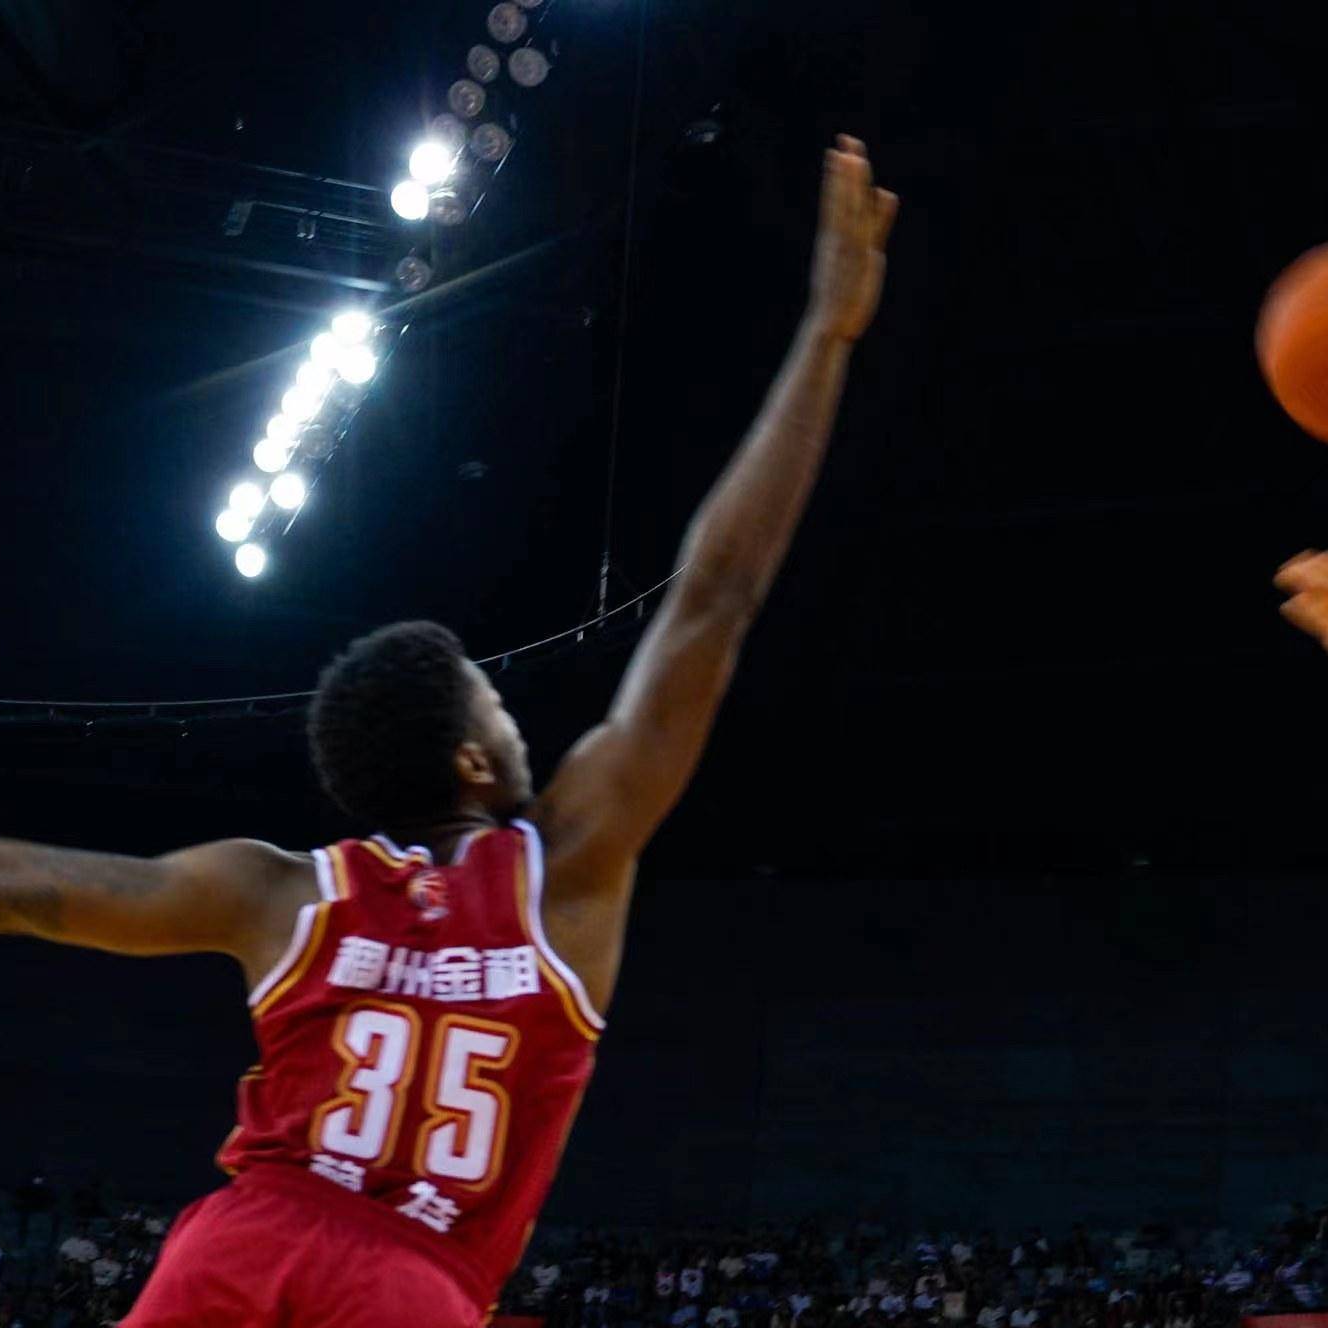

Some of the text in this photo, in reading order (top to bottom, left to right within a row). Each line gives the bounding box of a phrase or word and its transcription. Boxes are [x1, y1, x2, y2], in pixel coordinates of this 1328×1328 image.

[327, 935, 542, 1002] 稠州金租
[308, 999, 522, 1192] 35
